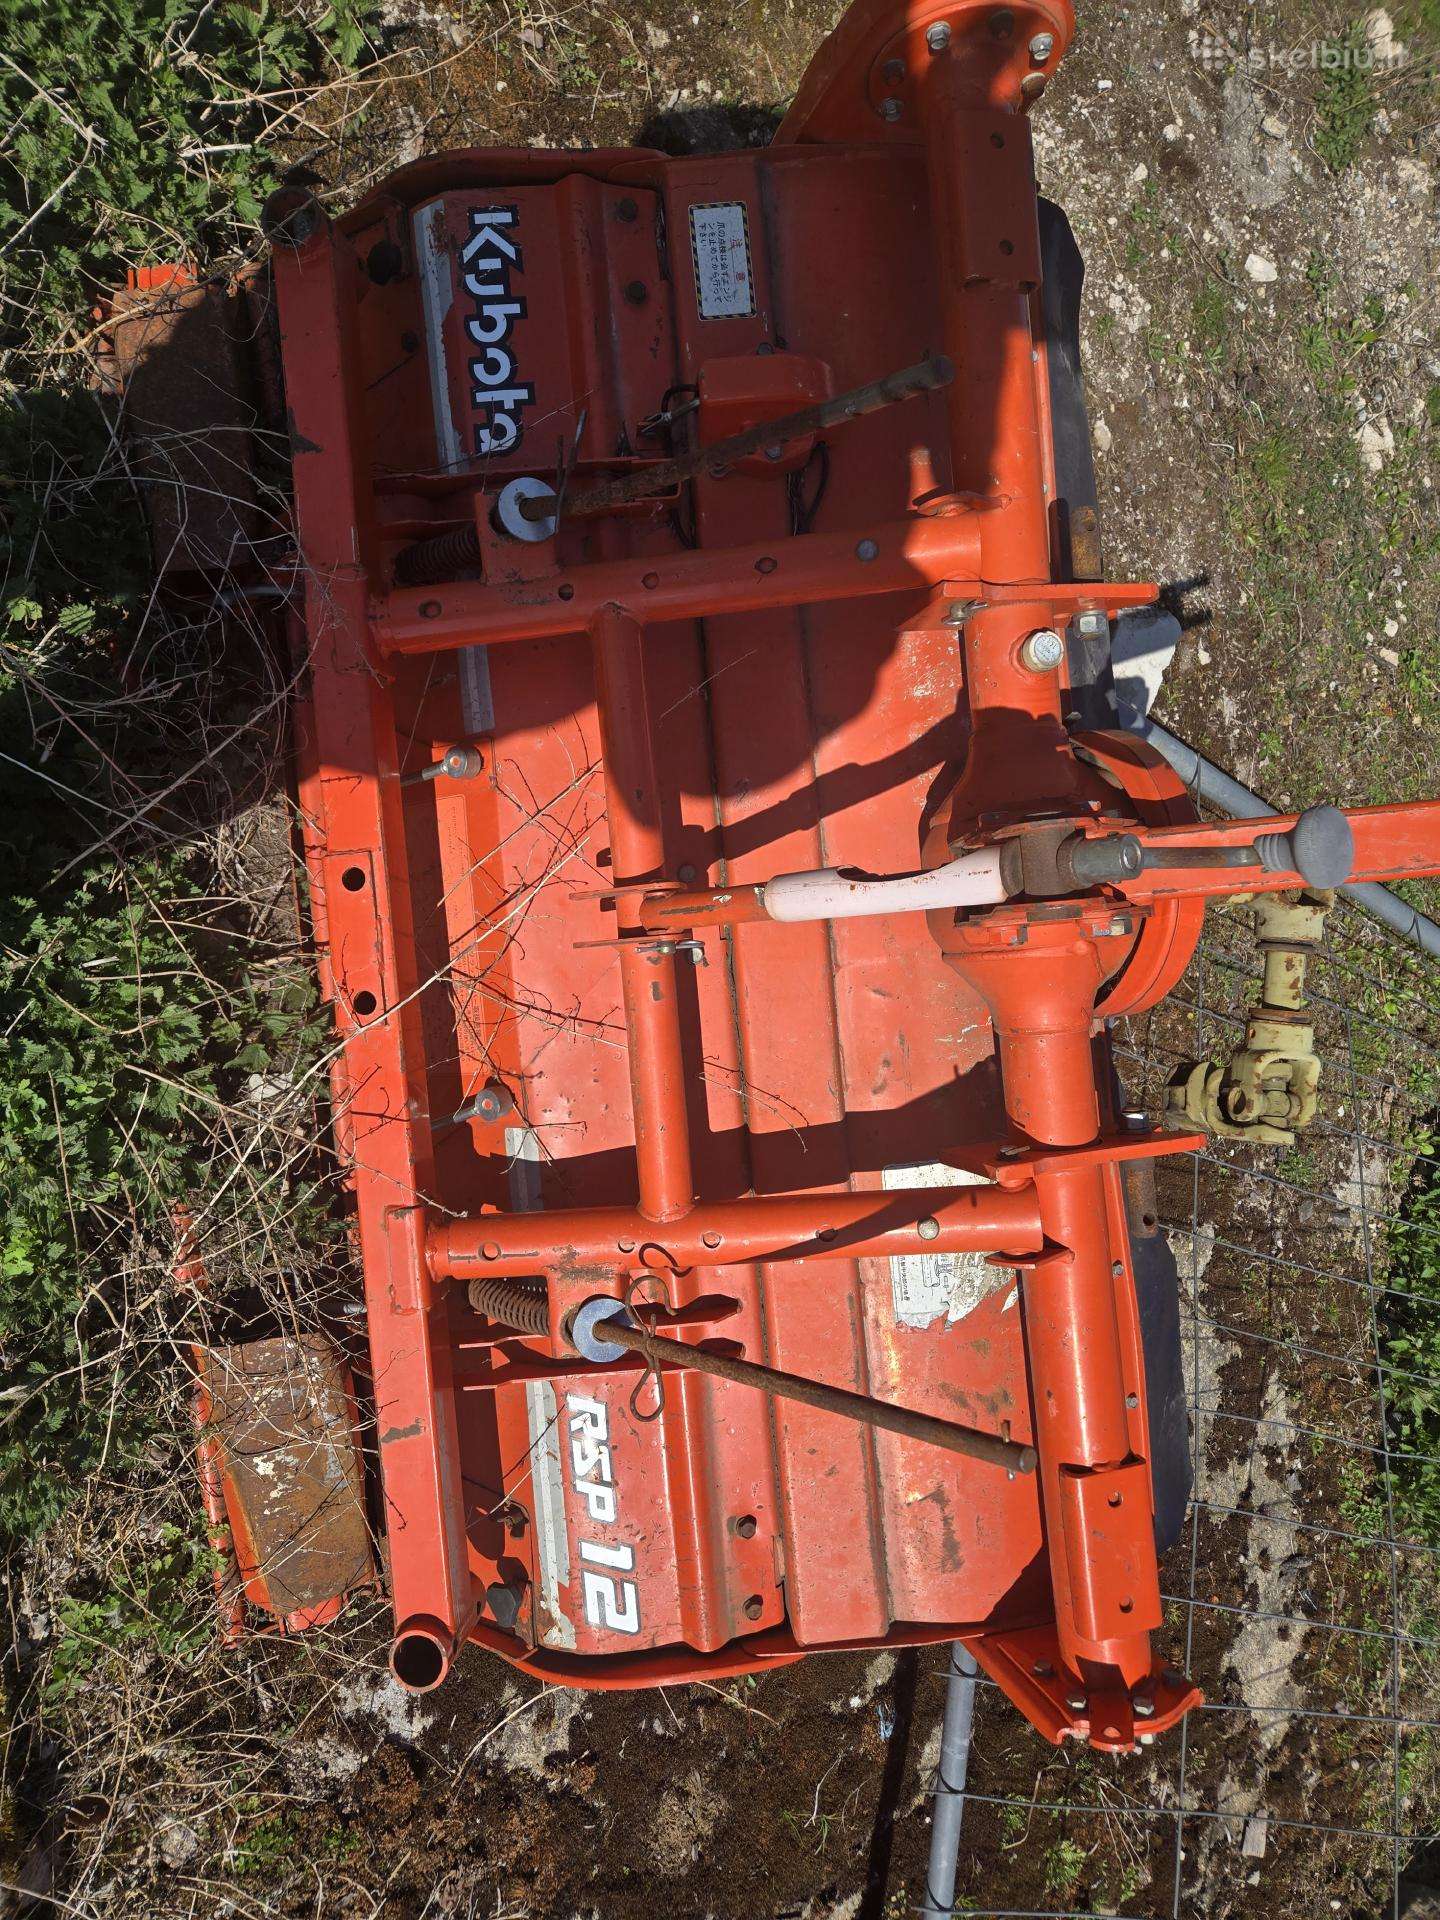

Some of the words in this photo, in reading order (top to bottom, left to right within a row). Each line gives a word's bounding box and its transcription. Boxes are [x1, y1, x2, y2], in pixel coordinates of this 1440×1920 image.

[461, 210, 530, 455] Kubota
[566, 1393, 618, 1524] RSP
[580, 1539, 641, 1634] 12
